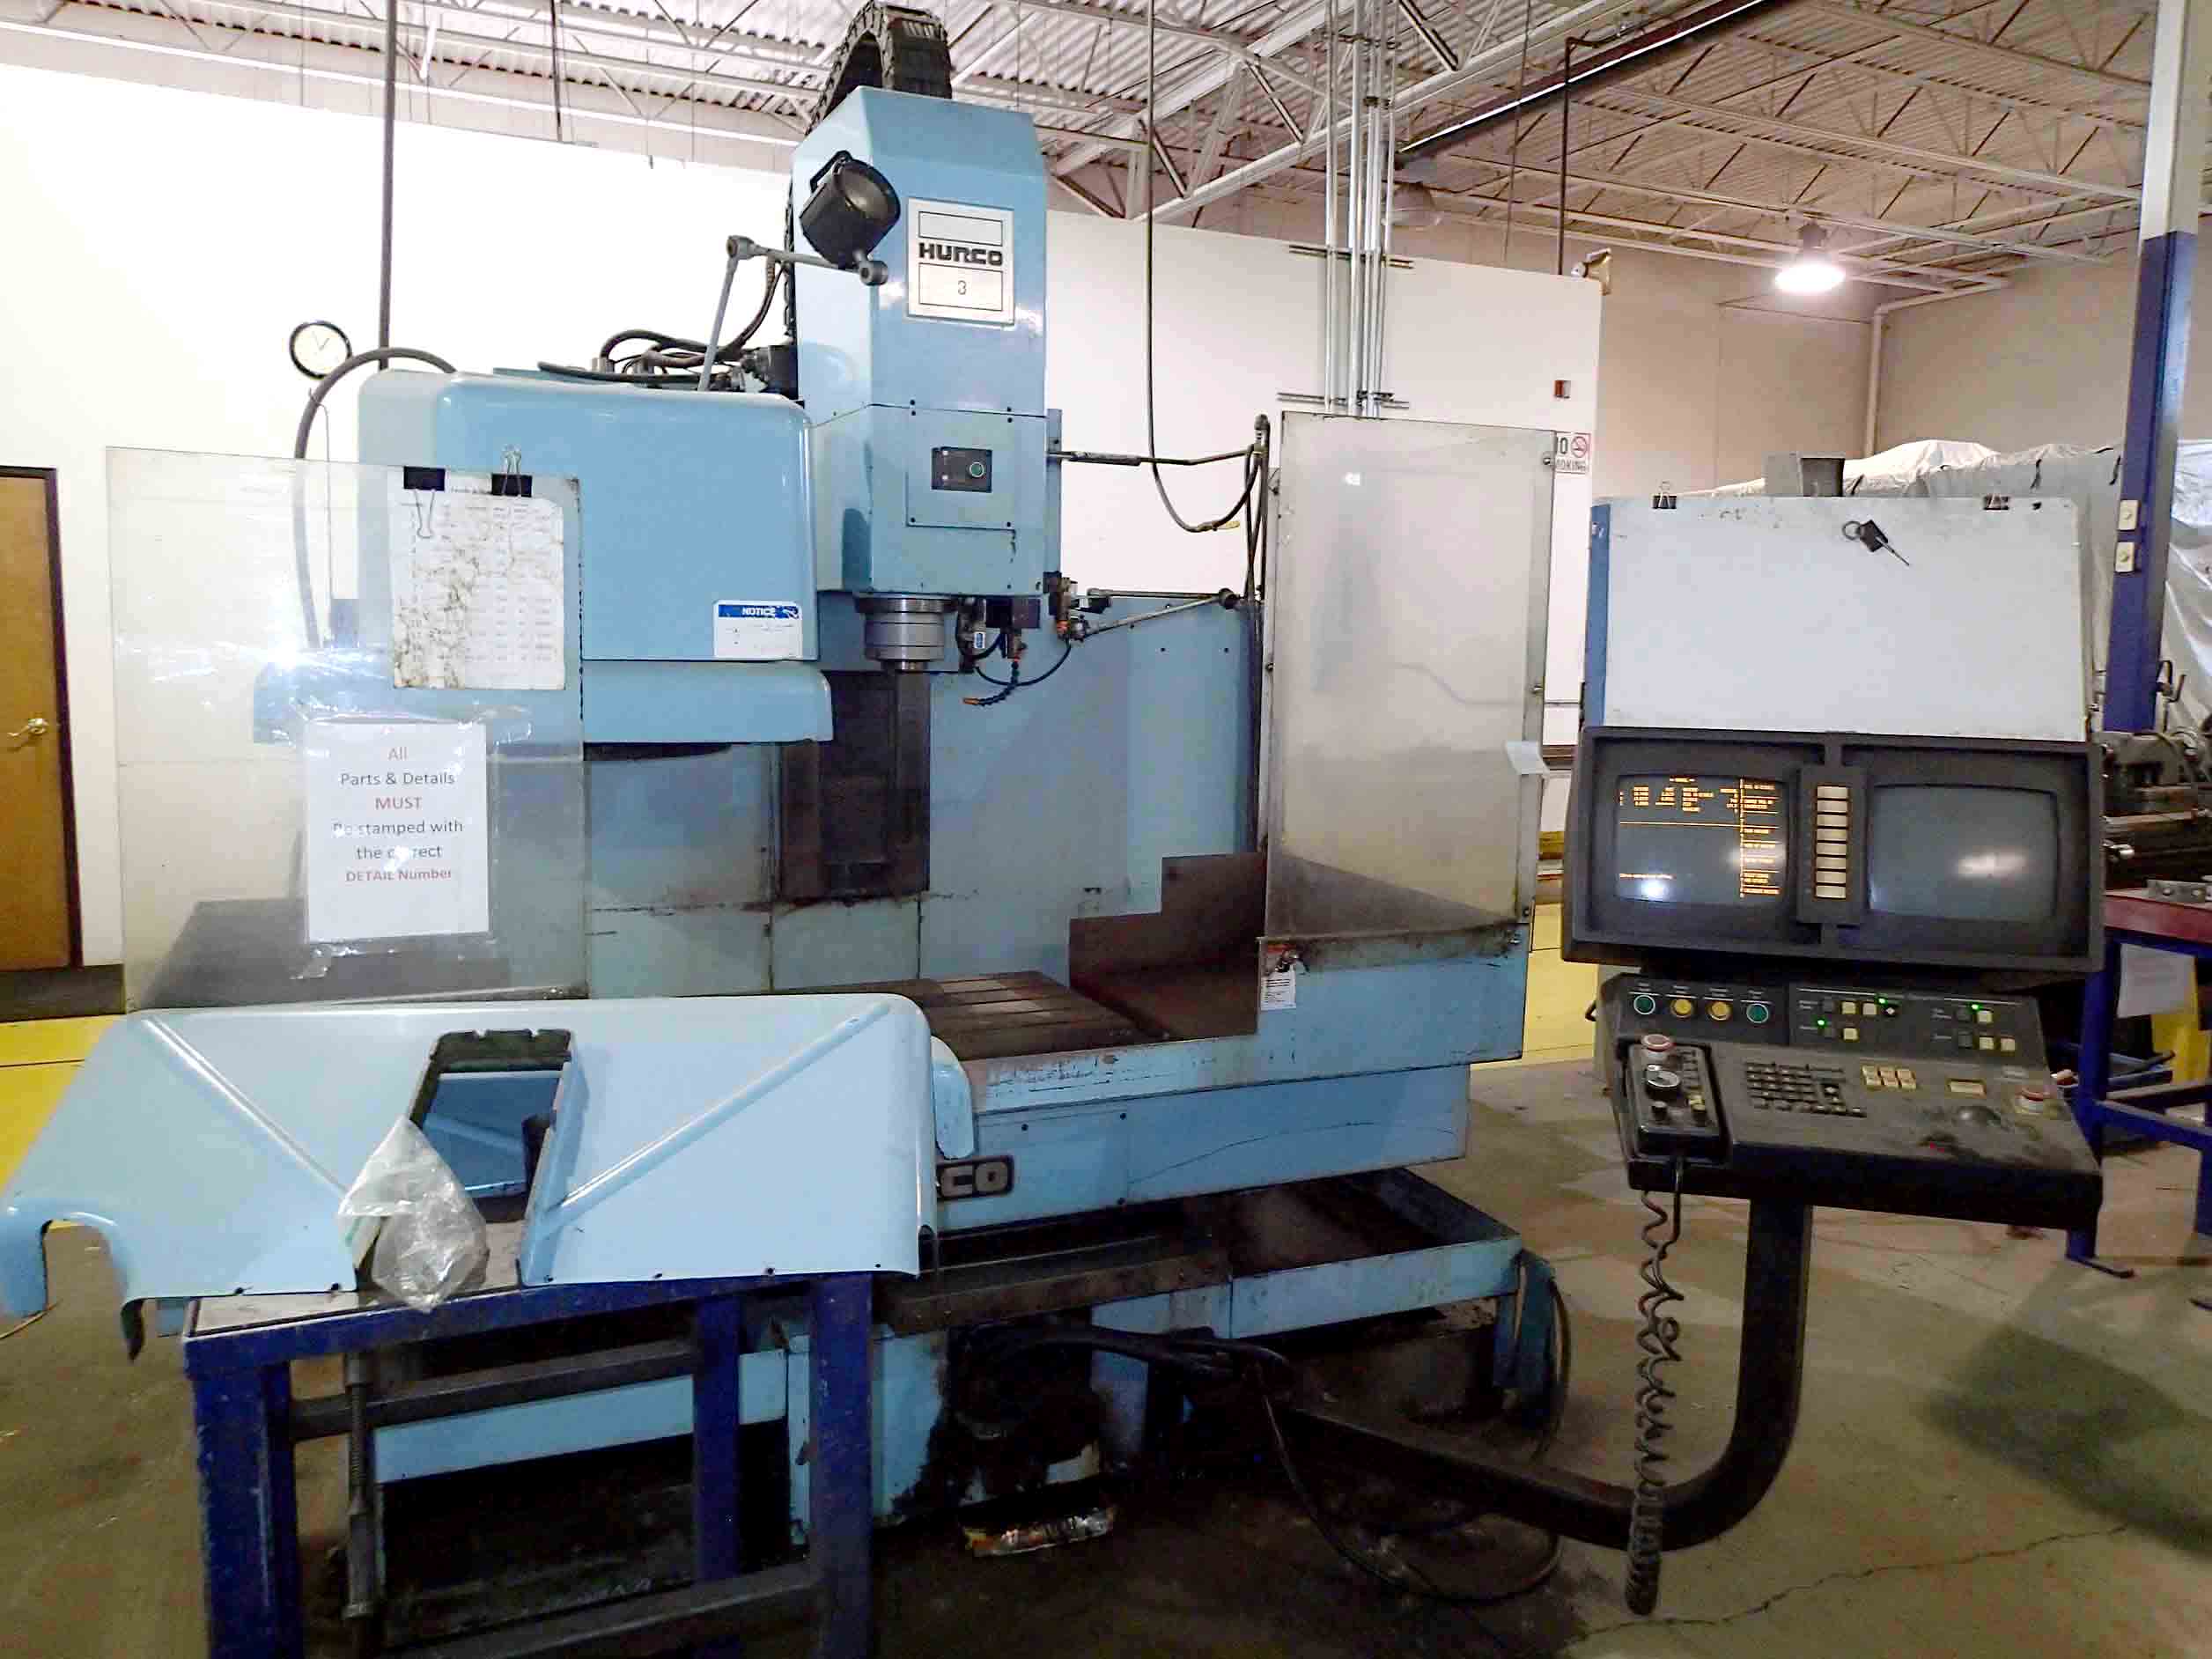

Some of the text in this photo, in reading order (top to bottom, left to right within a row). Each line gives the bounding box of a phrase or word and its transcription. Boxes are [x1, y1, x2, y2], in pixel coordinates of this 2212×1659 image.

[918, 242, 1003, 266] HURCO
[957, 280, 968, 295] 3
[741, 606, 776, 616] NOTICE
[387, 747, 408, 761] All
[340, 771, 455, 786] Parts & Details
[375, 797, 423, 810] MUST
[358, 820, 425, 836] stamped
[430, 819, 464, 832] with
[357, 846, 443, 860] the crect
[398, 867, 452, 881] Number
